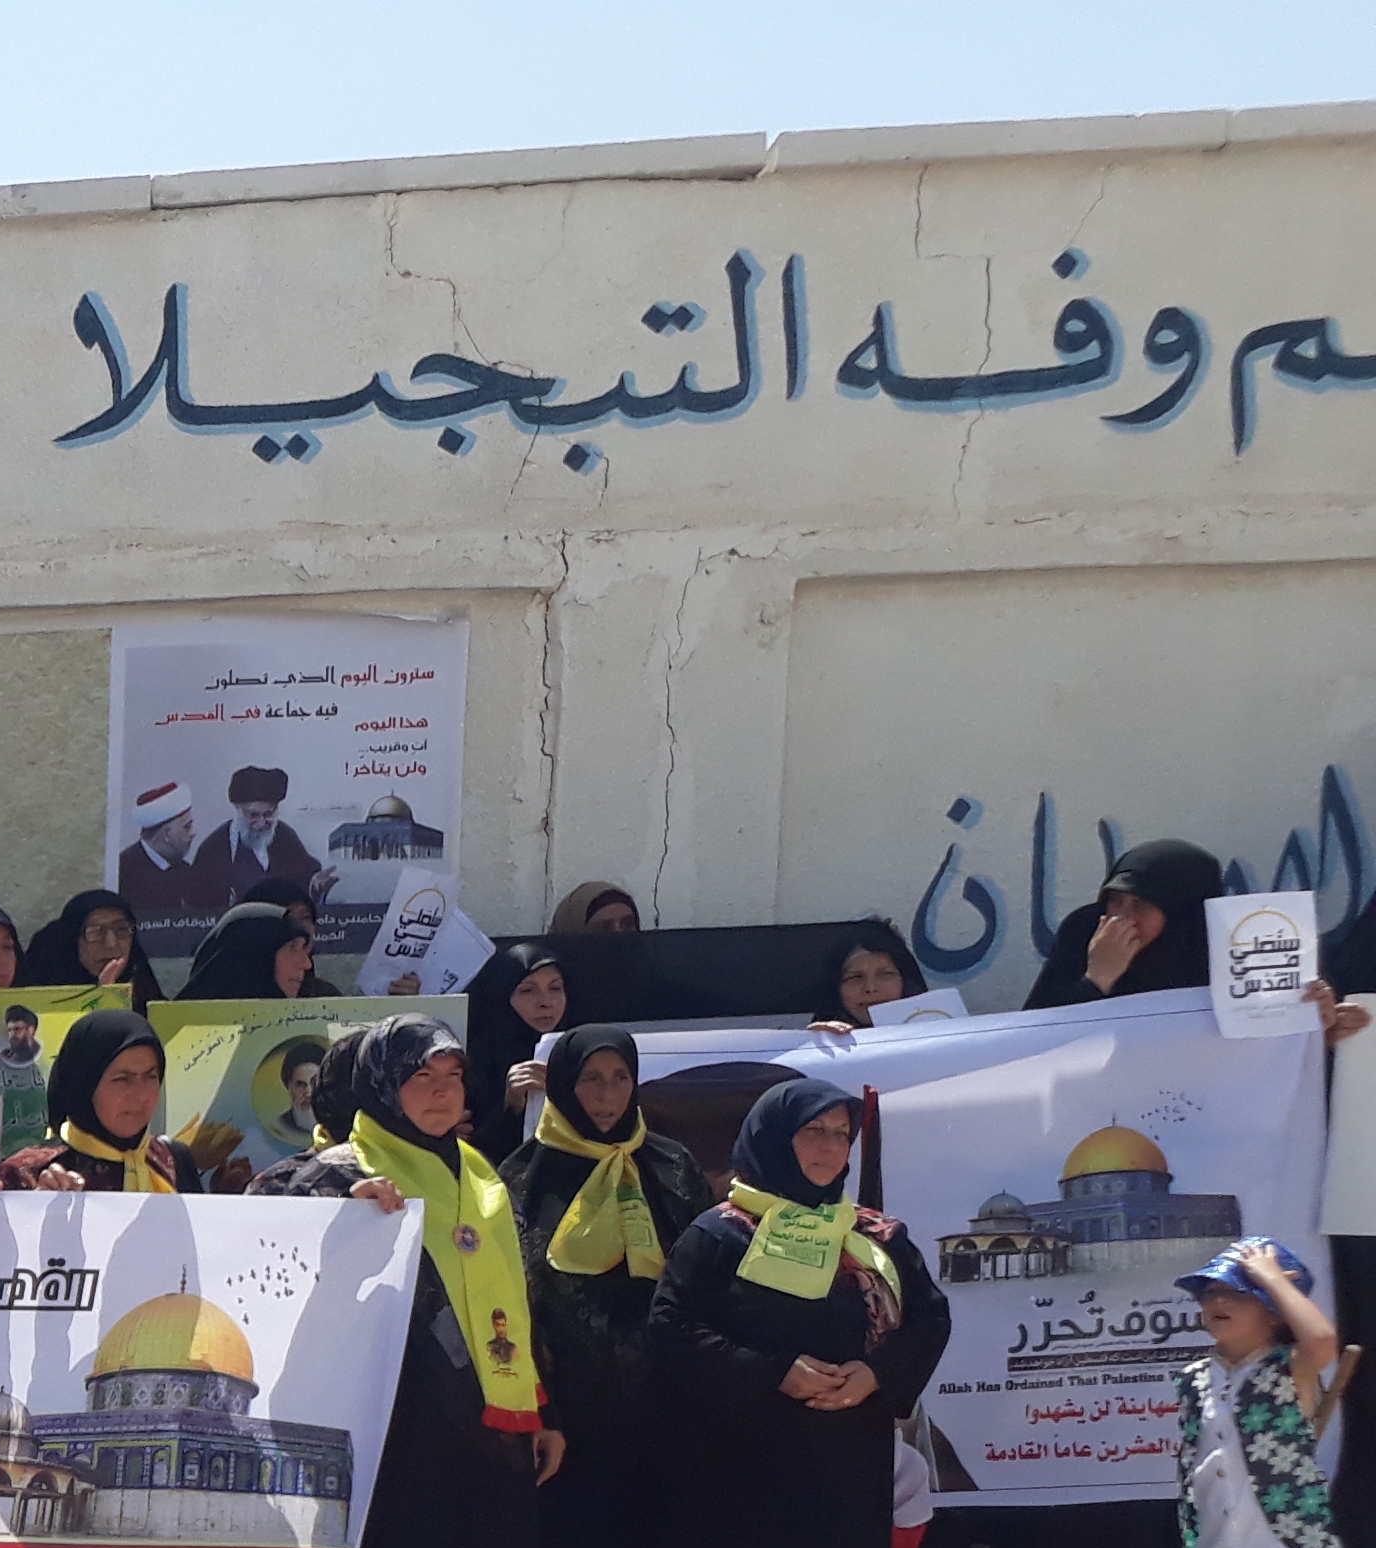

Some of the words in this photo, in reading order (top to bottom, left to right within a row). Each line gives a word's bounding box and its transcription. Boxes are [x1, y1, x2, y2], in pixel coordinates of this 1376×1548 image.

[55, 249, 804, 473] التبجيلا
[205, 669, 269, 691] تصلون
[273, 665, 335, 688] الذي
[340, 663, 378, 688] اليوم
[154, 703, 225, 726] القدس
[230, 707, 261, 724] في
[266, 701, 311, 722] جماعة
[315, 702, 339, 721] فيه
[399, 716, 428, 729] هذا
[354, 716, 396, 733] اليوم
[394, 761, 427, 778] ولن
[1229, 954, 1300, 981] في
[938, 1380, 973, 1394] Allah
[976, 1380, 1001, 1393] Has
[1005, 1376, 1064, 1391] Ordained
[1068, 1375, 1098, 1387] That
[1103, 1371, 1165, 1385] Palestine
[1024, 1398, 1085, 1424] يشهدوا
[1090, 1399, 1111, 1422] لن
[985, 1441, 1049, 1462] القادمة
